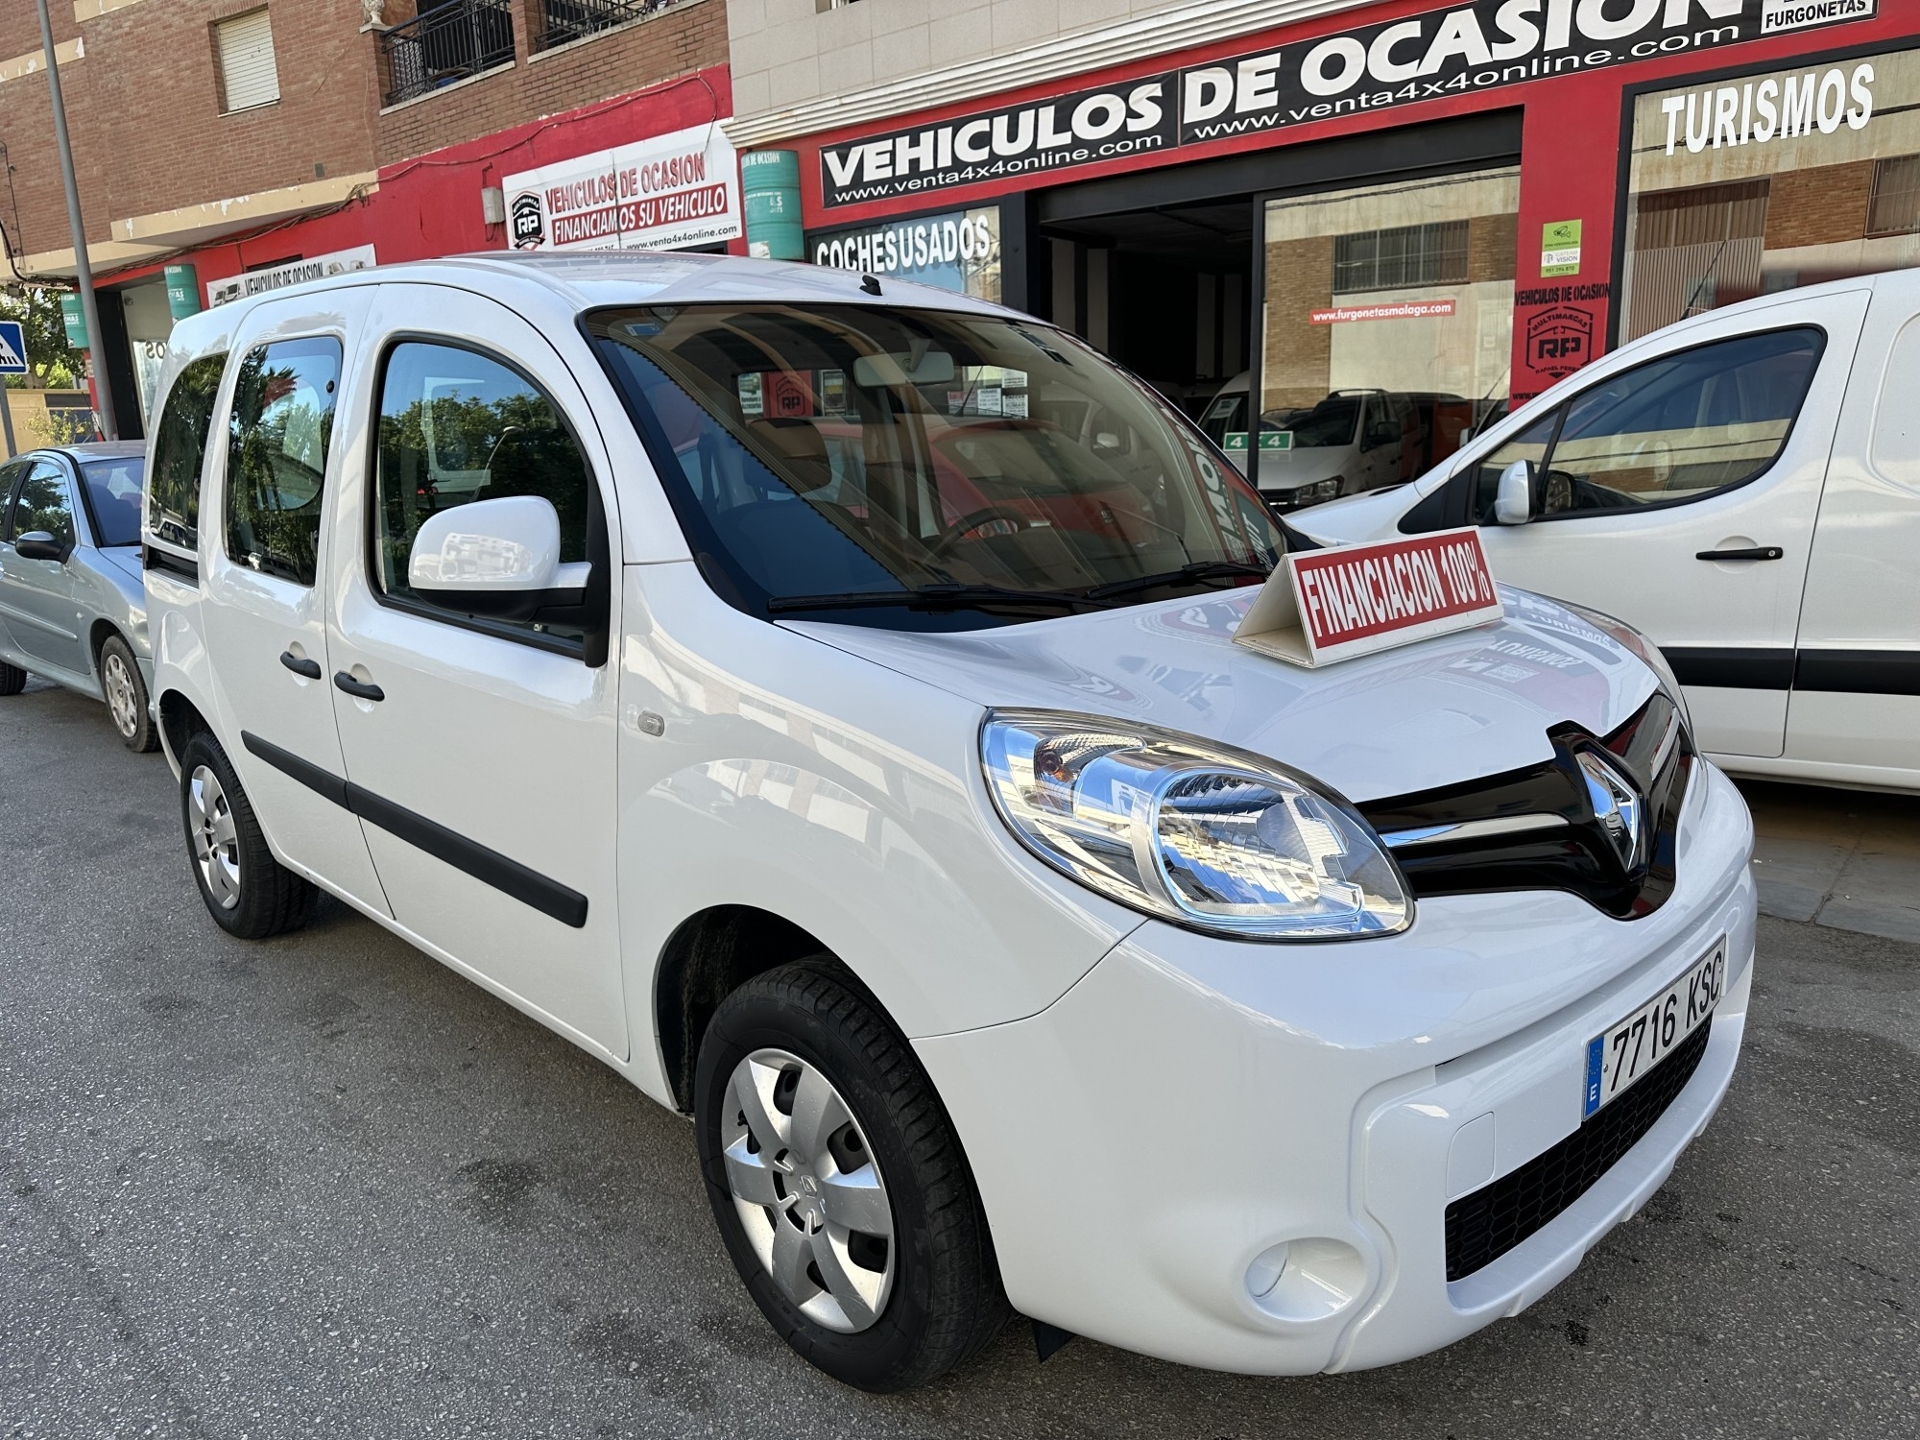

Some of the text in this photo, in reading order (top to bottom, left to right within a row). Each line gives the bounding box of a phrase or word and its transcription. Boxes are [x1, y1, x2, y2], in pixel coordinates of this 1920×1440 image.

[1765, 0, 1866, 28] FURGONETAS
[1194, 24, 1739, 138] www.venta4x4online.com
[823, 83, 1163, 188] VEHICULOS
[1183, 52, 1282, 124] DE
[1661, 63, 1875, 156] TURISMOS
[834, 134, 1163, 203] www.venta4x4online.com
[545, 152, 706, 215] VEHICULOS DE OCASION
[517, 214, 539, 235] RP
[555, 186, 725, 244] FINANCIAMOS SU VEHICULO
[627, 224, 738, 250] www.venta4x4online.com
[1556, 255, 1578, 263] VISION
[1515, 282, 1611, 306] VEHICULOS DE OCASION
[1313, 303, 1452, 322] www.furgonetasmalaga.com
[1532, 313, 1588, 332] MULTIMARCAS
[1538, 336, 1581, 359] RP
[1535, 366, 1559, 374] RAFAEL
[1301, 541, 1492, 638] FINANCIACION 100%
[1611, 951, 1722, 1092] 7716 KSC
[1589, 1083, 1598, 1102] E
